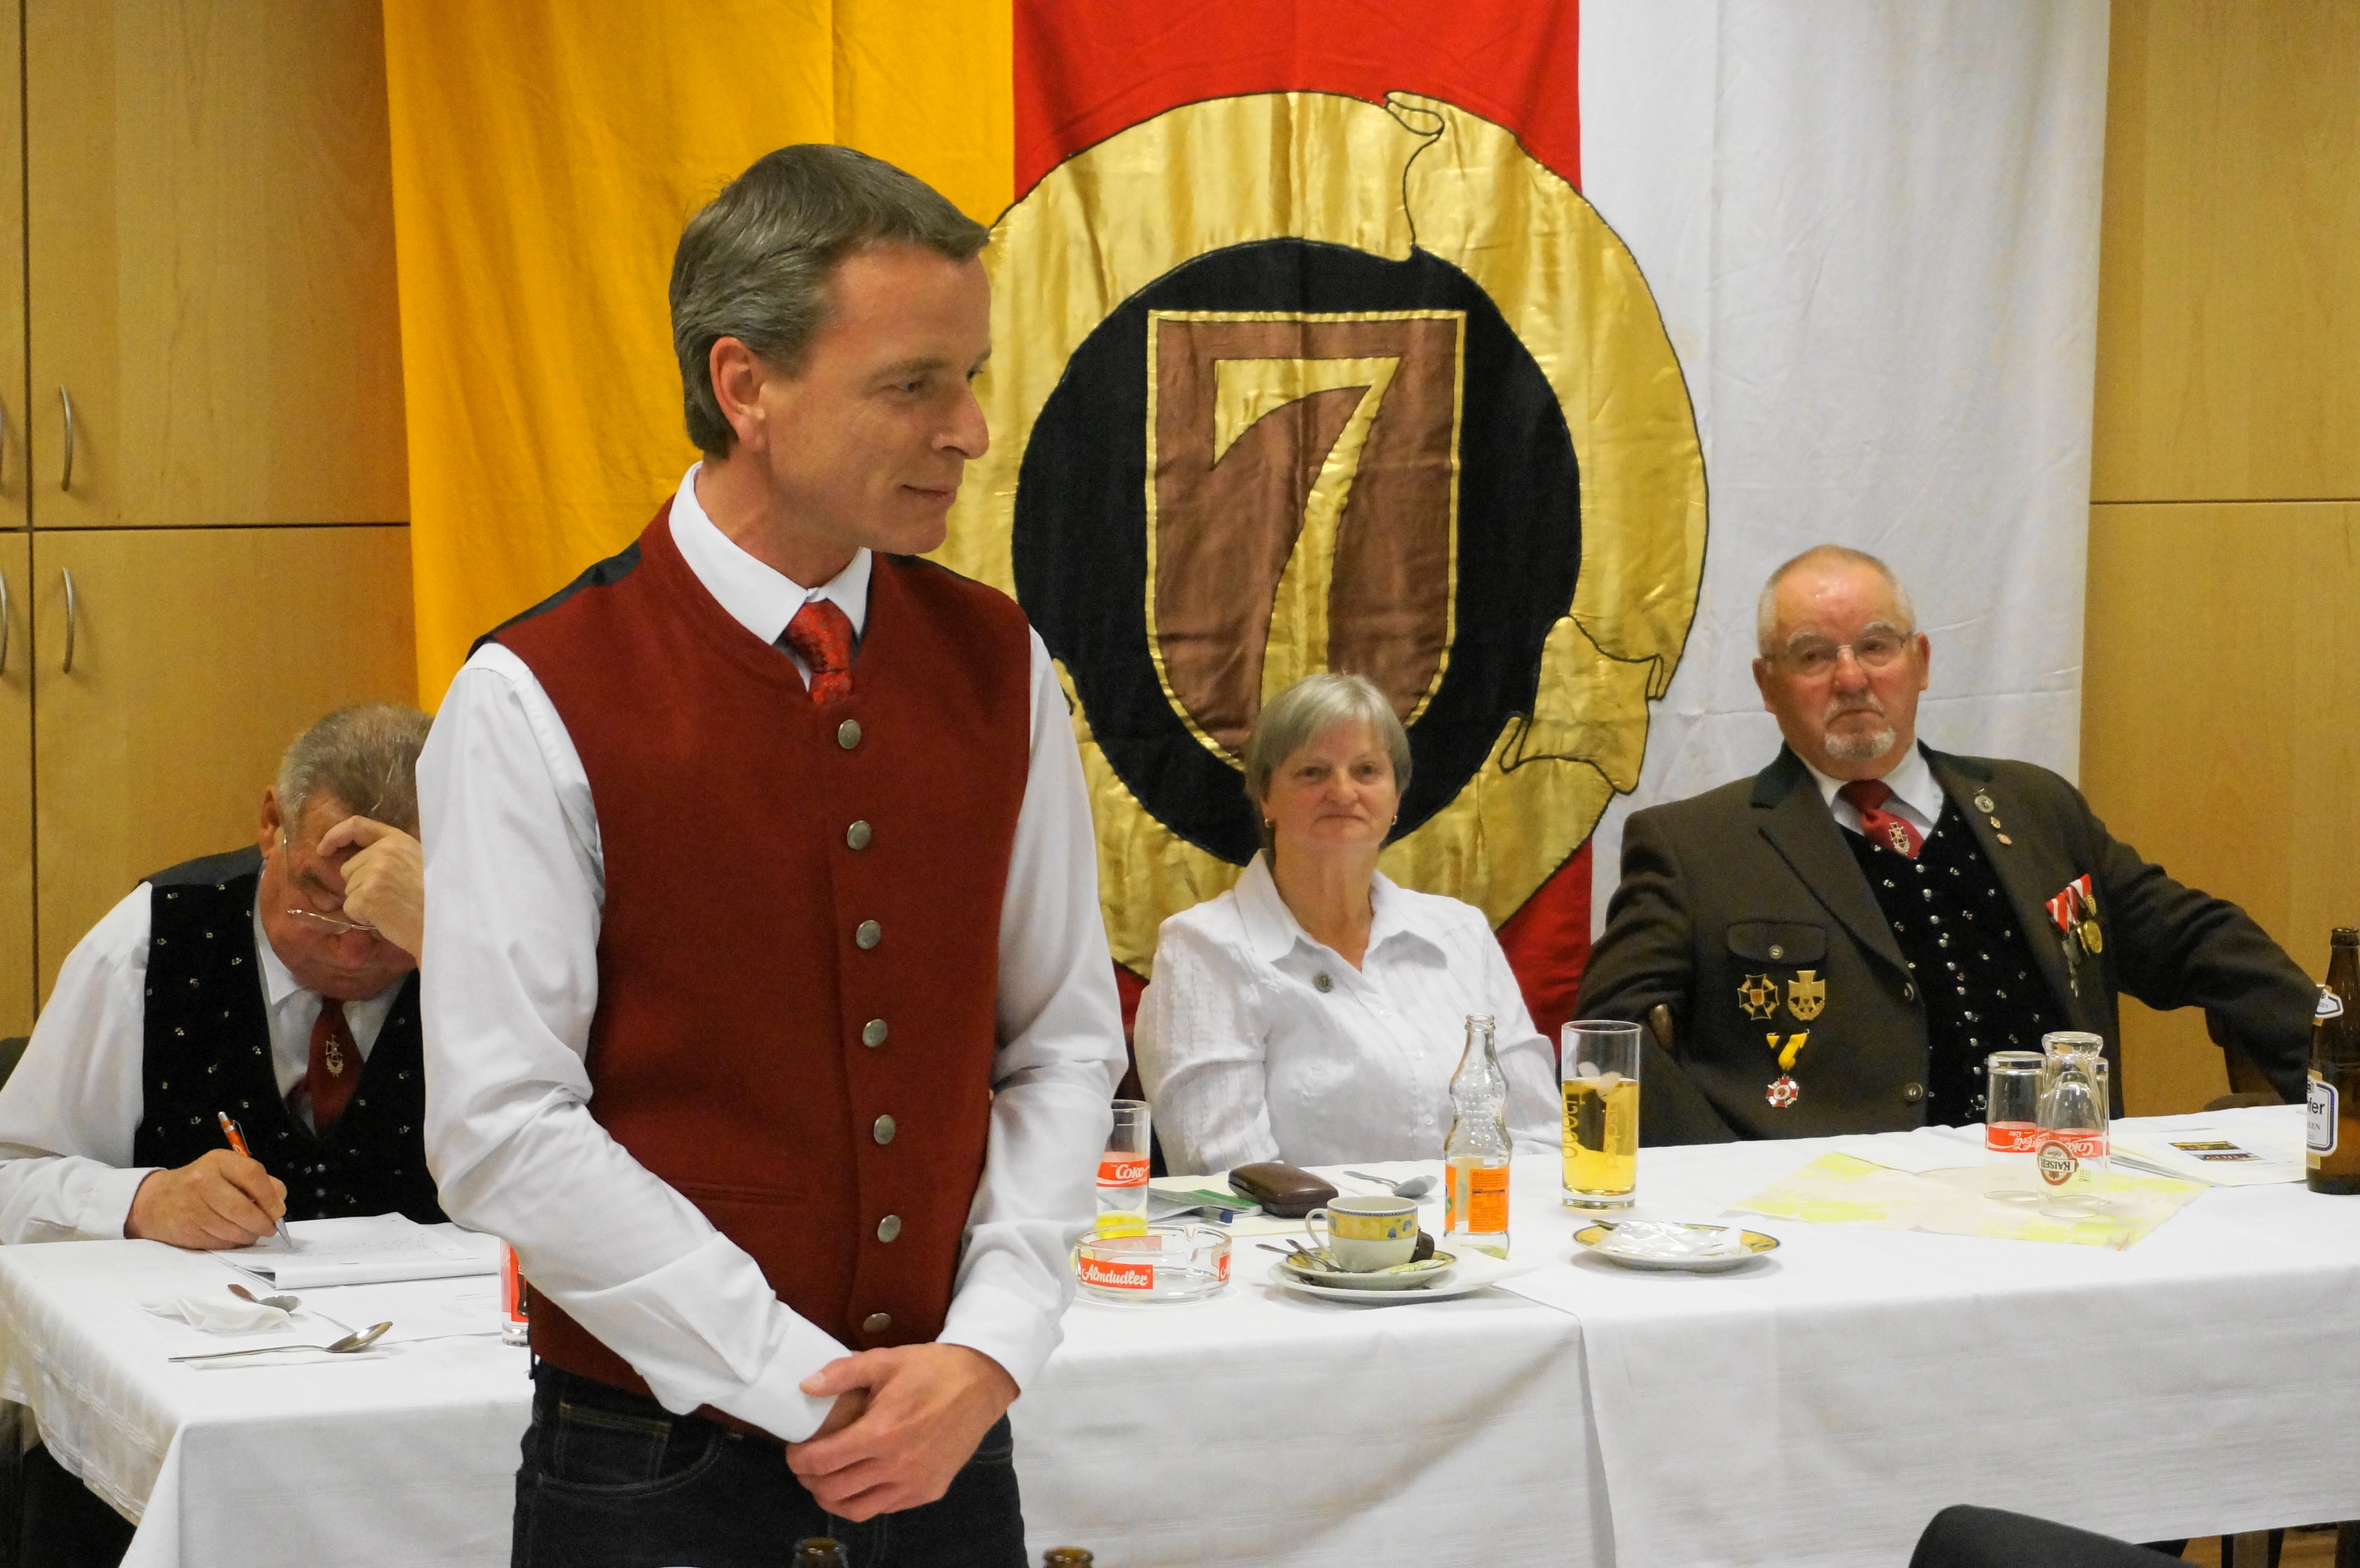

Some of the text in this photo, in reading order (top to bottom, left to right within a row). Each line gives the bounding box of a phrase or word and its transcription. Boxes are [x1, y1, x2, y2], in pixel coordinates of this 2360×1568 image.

[1212, 356, 1401, 710] 7
[1115, 1164, 1144, 1179] Coke
[2040, 1158, 2071, 1171] KAISER
[1082, 1264, 1148, 1286] Almdudler
